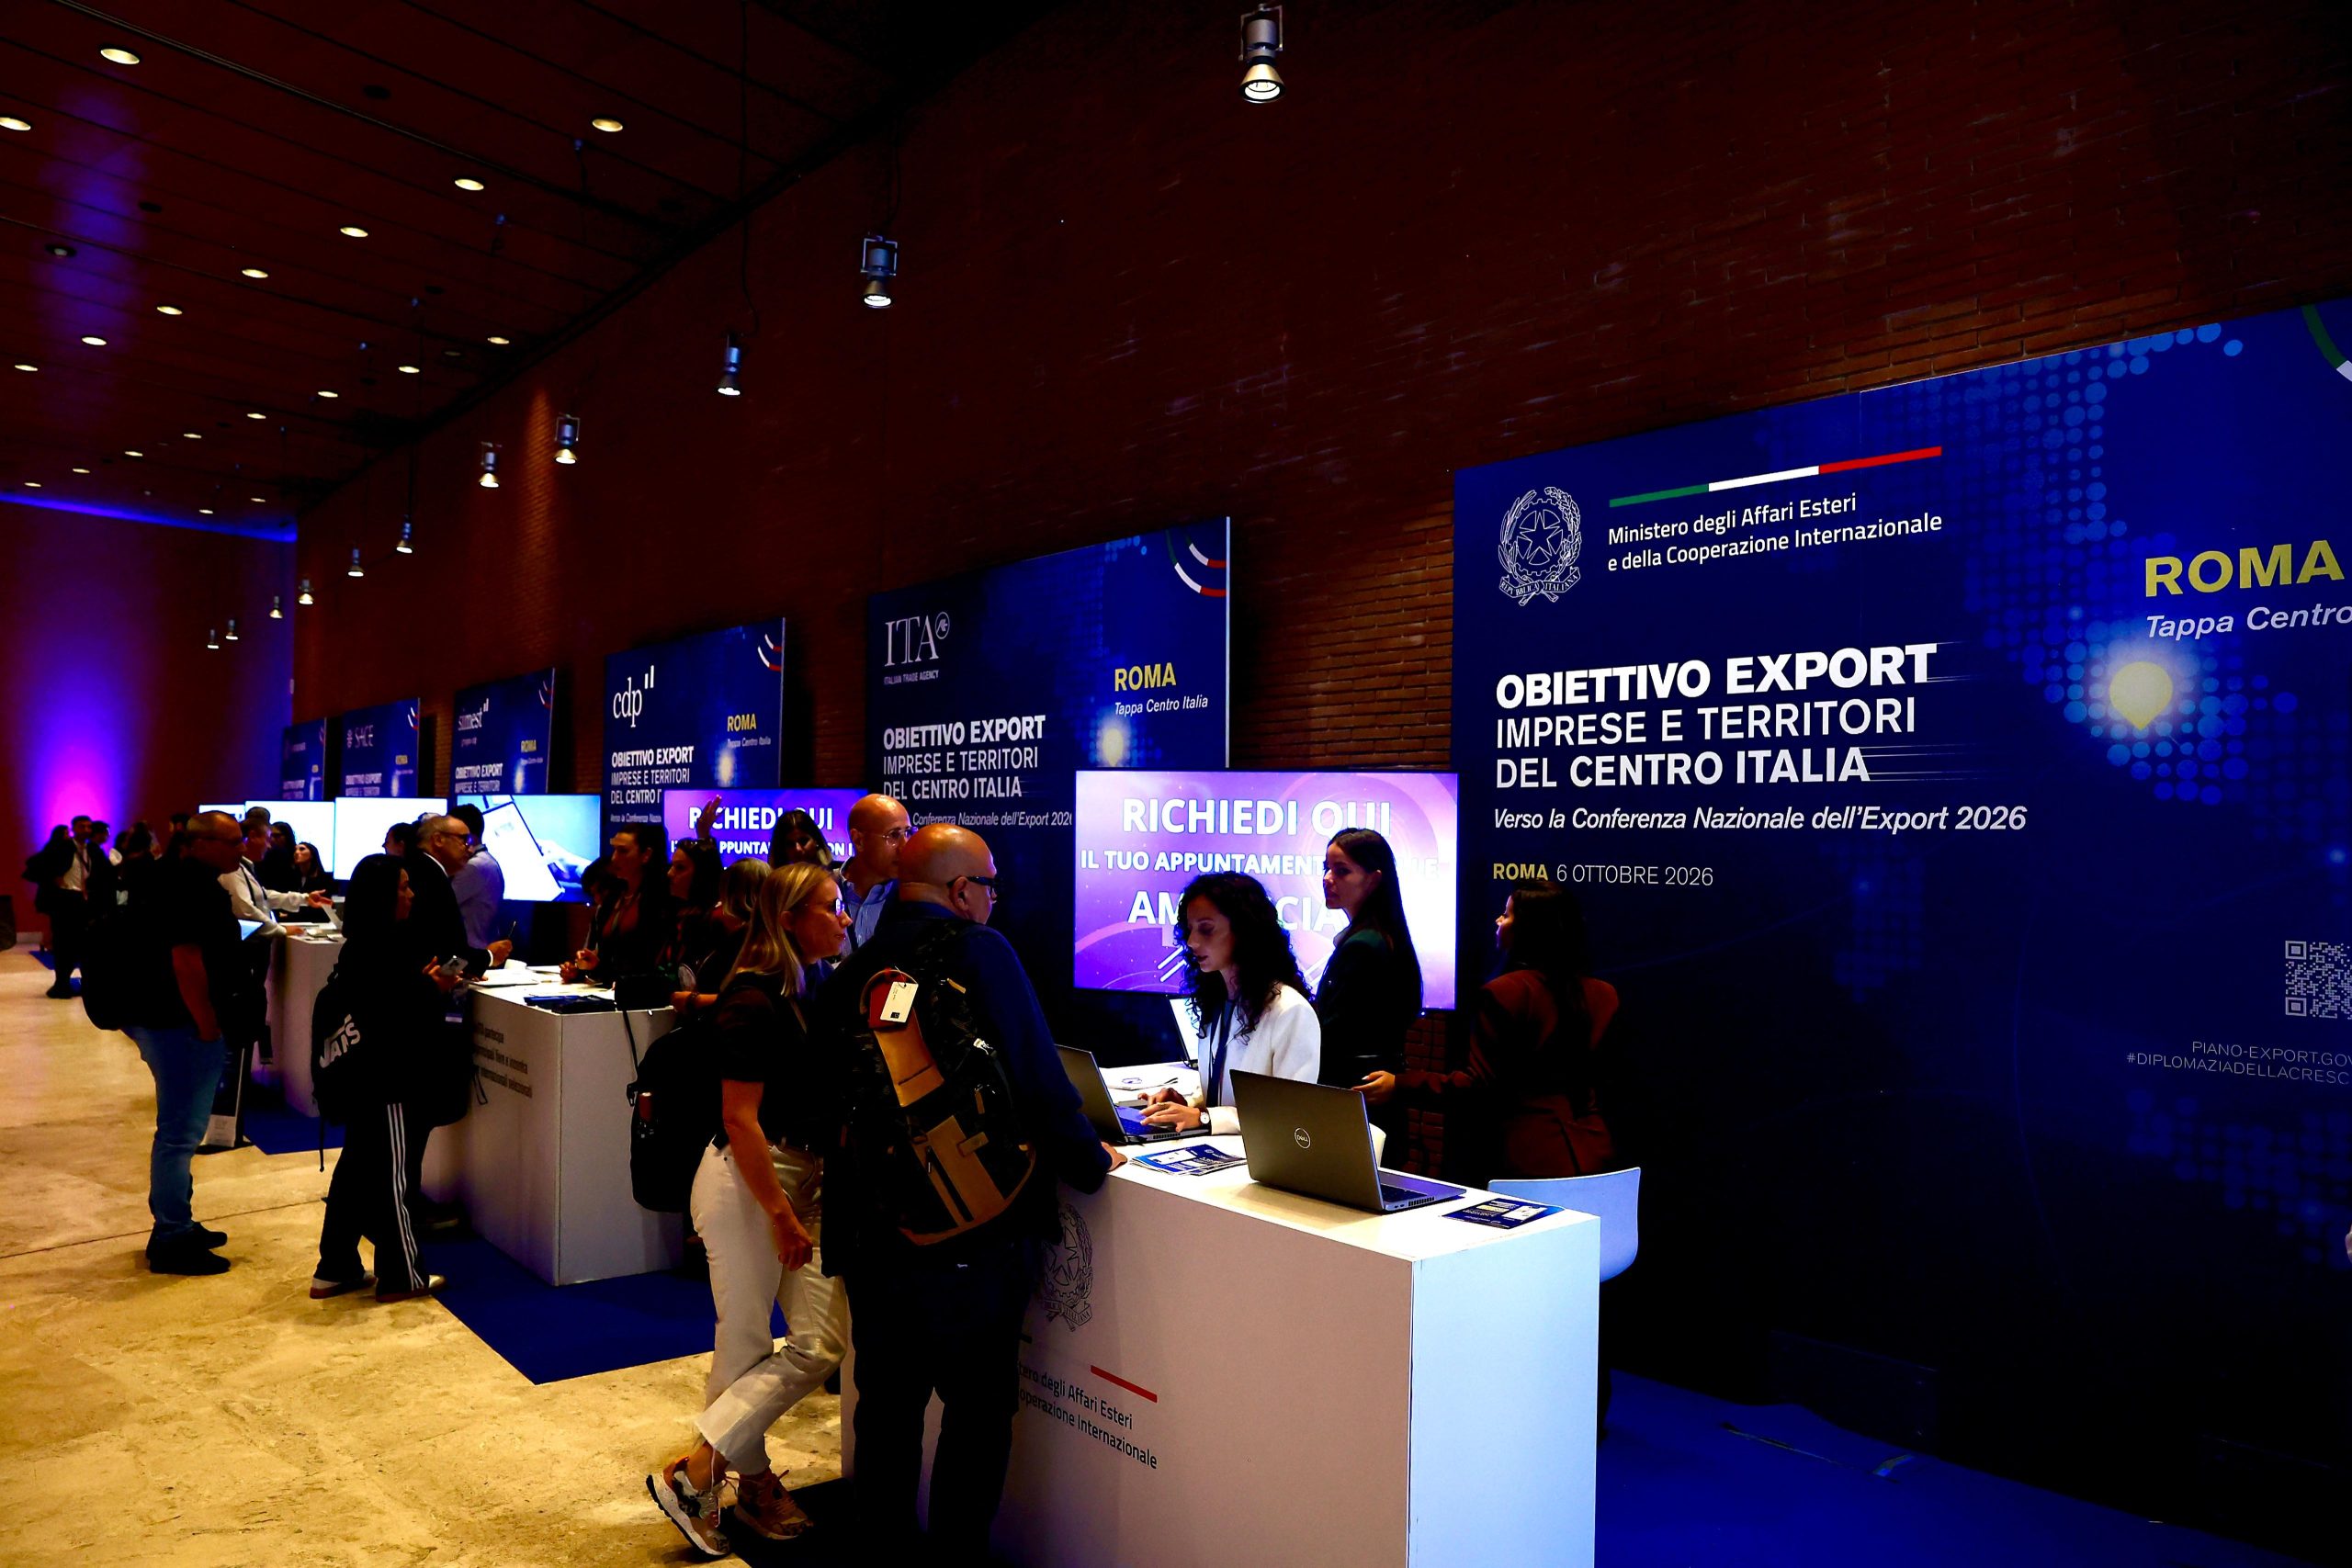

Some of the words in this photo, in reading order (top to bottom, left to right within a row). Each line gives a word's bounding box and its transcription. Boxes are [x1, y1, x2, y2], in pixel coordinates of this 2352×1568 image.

[1609, 518, 1689, 546] Ministero
[1694, 511, 1736, 536] degli
[1742, 501, 1793, 527] Affari
[1800, 492, 1857, 519] Esteri
[1608, 557, 1617, 571] e
[1622, 546, 1662, 569] della
[1667, 532, 1790, 568] Cooperazione
[1795, 513, 1942, 548] Internazionale
[2145, 539, 2345, 597] ROMA
[2146, 615, 2234, 641] Tappa
[2247, 603, 2352, 631] Centro
[884, 615, 939, 667] ITA
[1114, 661, 1176, 692] ROMA
[1496, 660, 1711, 709] OBIETTIVO
[1726, 642, 1938, 694] EXPORT
[613, 676, 642, 728] cdp
[1114, 701, 1143, 716] Tappa
[1146, 696, 1180, 713] Centro
[1182, 694, 1208, 709] Italia
[727, 714, 757, 732] ROMA
[883, 721, 966, 750] OBIETTIVO
[969, 714, 1046, 744] EXPORT
[1497, 711, 1646, 749] IMPRESE
[1662, 707, 1683, 741] E
[1698, 696, 1916, 740] TERRITORI
[611, 749, 654, 768] OBIETTIVO
[656, 746, 695, 764] EXPORT
[883, 754, 941, 775] IMPRESE
[946, 750, 955, 772] E
[959, 746, 1039, 771] TERRITORI
[1497, 758, 1557, 789] DEL
[1569, 751, 1723, 787] CENTRO
[1736, 747, 1871, 784] ITALIA
[611, 770, 641, 785] IMPRESE
[644, 770, 649, 784] E
[650, 768, 690, 784] TERRITORI
[883, 780, 908, 801] DEL
[911, 778, 970, 800] CENTRO
[974, 775, 1023, 798] ITALIA
[610, 789, 624, 804] DEL
[626, 788, 656, 804] CENTRO
[689, 807, 784, 830] RCHIED
[912, 812, 956, 826] Conferenza
[958, 812, 999, 826] Nazionale
[1001, 811, 1050, 829] dell'Export
[1123, 798, 1297, 835] RICHIEDI
[1312, 801, 1391, 837] QUI
[1494, 808, 1544, 830] Verso
[1548, 809, 1566, 829] la
[1572, 807, 1688, 830] Conferenza
[1693, 807, 1805, 830] Nazionale
[1955, 806, 2028, 831] 2026
[1080, 850, 1099, 869] IL
[1104, 851, 1149, 872] TUO
[1155, 852, 1326, 876] APPUNTAMENT
[1492, 862, 1549, 883] ROMA
[1556, 864, 1568, 884] 6
[1572, 864, 1659, 885] OTTOBRE
[1665, 866, 1714, 886] 2026
[2127, 1052, 2350, 1085] #DIPLOMAZIADELLACRESC
[1041, 1371, 1065, 1397] degli
[1069, 1385, 1097, 1412] Affari
[1100, 1401, 1132, 1430] Esteri
[1019, 1389, 1075, 1427] operazione
[1078, 1415, 1158, 1470] Internazionale
